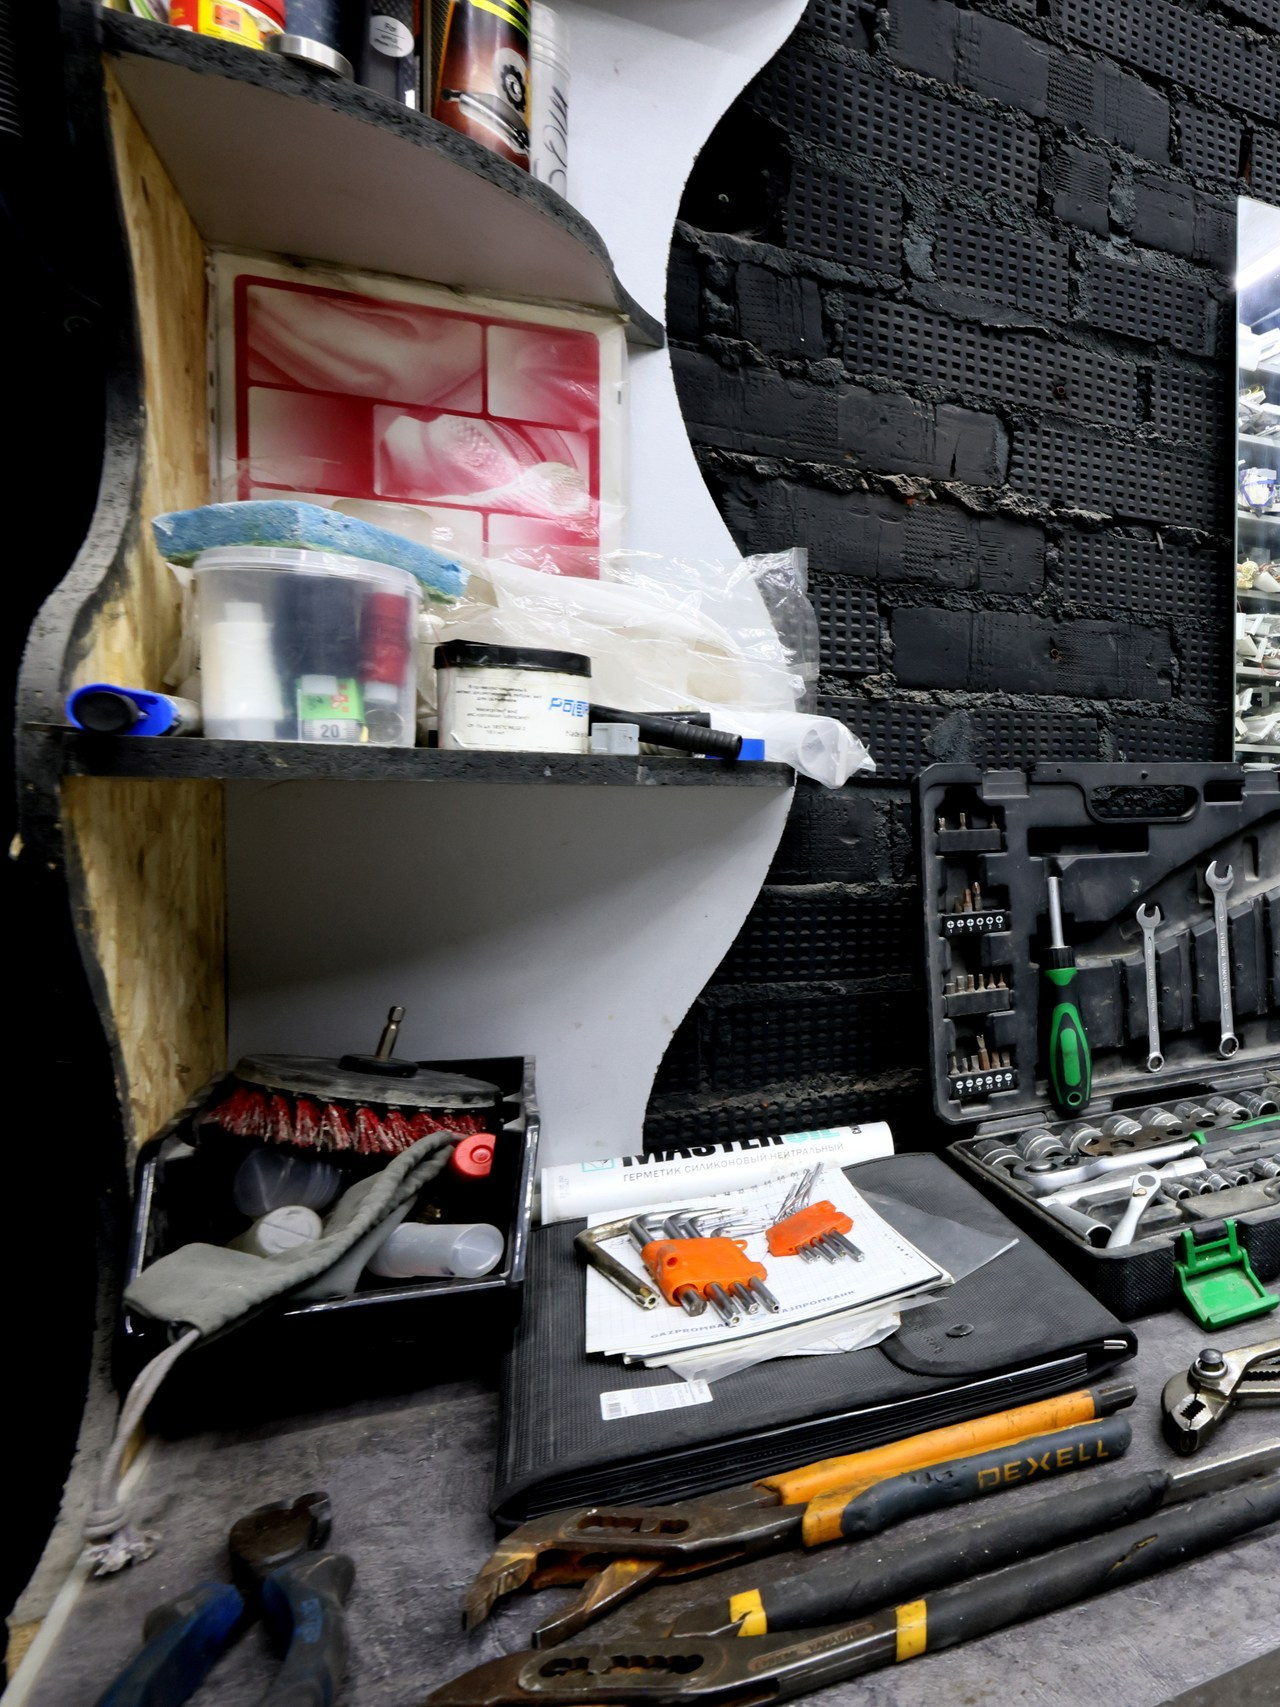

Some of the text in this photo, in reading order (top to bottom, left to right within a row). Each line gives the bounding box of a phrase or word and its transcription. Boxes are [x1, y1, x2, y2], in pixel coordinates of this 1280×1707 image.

[320, 724, 339, 738] 20
[623, 1142, 844, 1183] ГЕРМЕТИК СИЛИКОНОВЫЙ НЕЙТРАЛЬНЫЙ
[978, 1439, 1109, 1489] DEXELL
